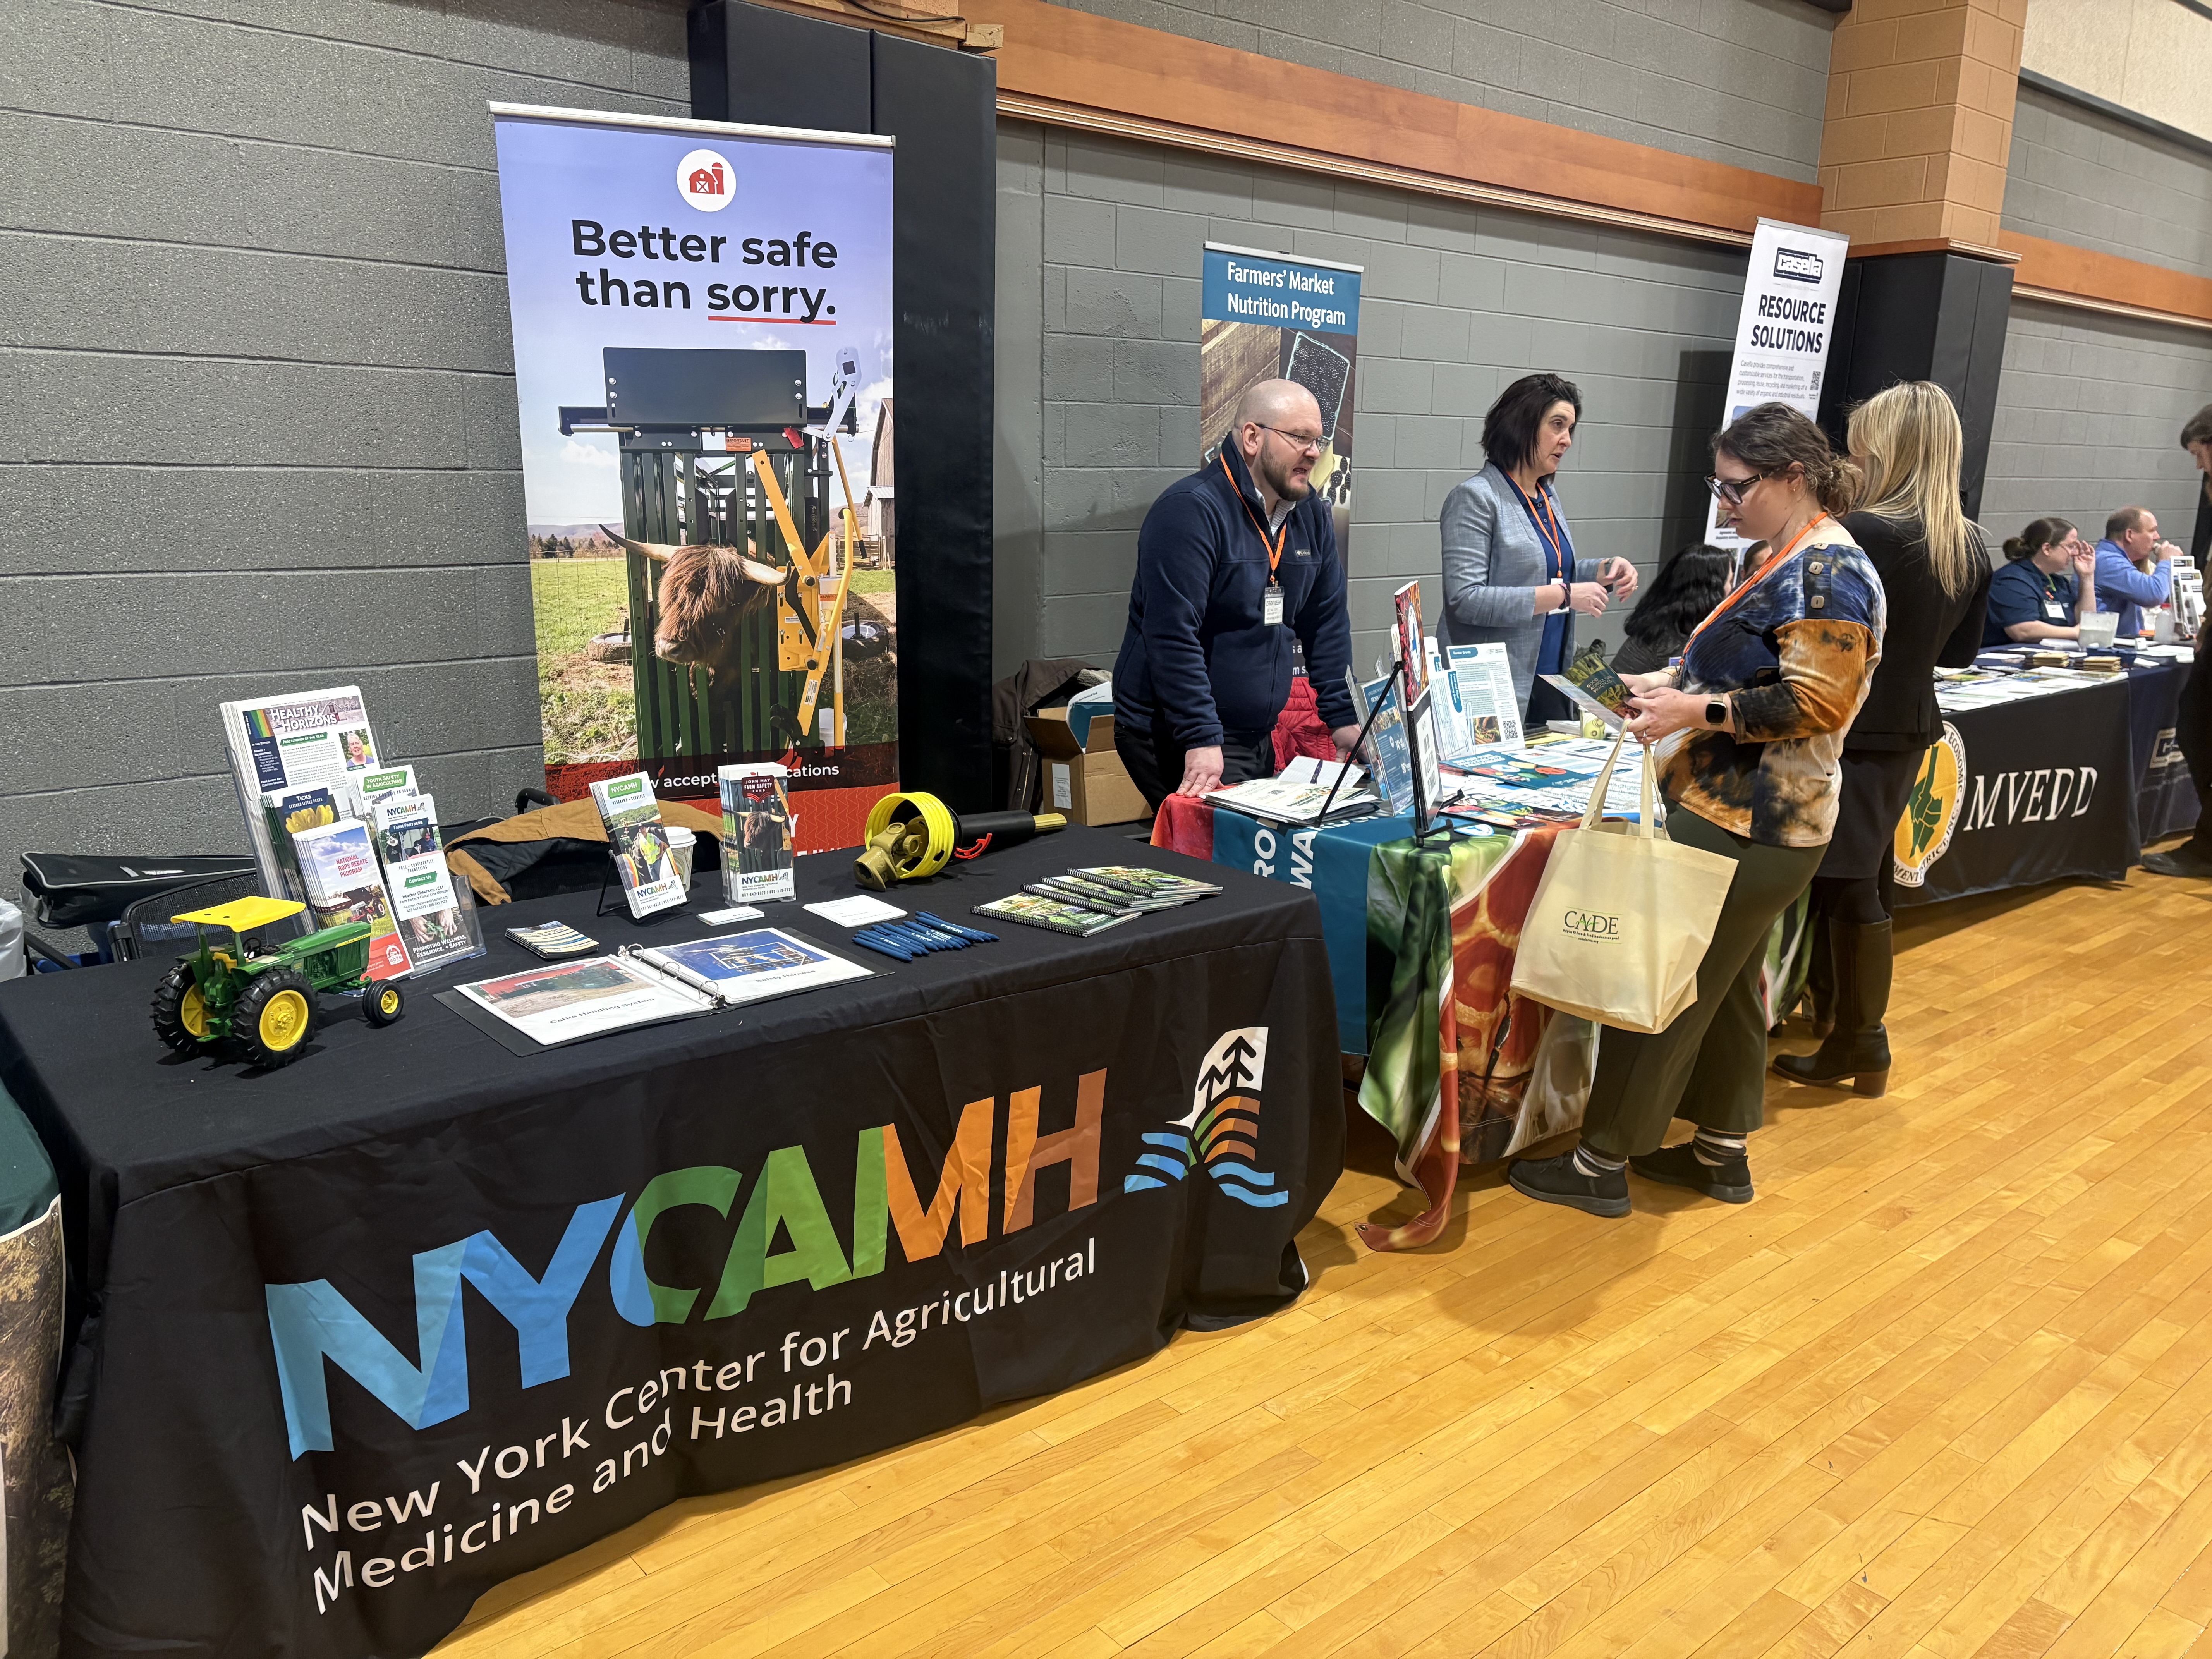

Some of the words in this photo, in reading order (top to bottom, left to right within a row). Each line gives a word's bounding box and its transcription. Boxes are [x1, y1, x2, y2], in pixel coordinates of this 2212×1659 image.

[572, 219, 726, 263] Better
[742, 231, 838, 268] safe
[1289, 271, 1334, 295] Market
[576, 268, 690, 309] than
[708, 284, 836, 323] sorry.
[1228, 293, 1288, 319] Nutrition
[1291, 301, 1345, 328] Program
[1758, 294, 1826, 324] RESOURCE
[1751, 325, 1823, 353] SOLUTIONS
[270, 705, 319, 721] HEALTHY
[281, 714, 338, 732] HORIZONS
[1949, 731, 1963, 793] ECONOMIC
[372, 779, 403, 788] AGRICULTURE
[611, 781, 638, 793] NYCAMH
[664, 774, 718, 790] accept
[787, 764, 839, 778] cations
[386, 804, 417, 816] NYCAMH
[1964, 766, 2098, 831] MVEDD
[336, 854, 359, 865] NATIONAL
[338, 863, 351, 871] ROPS
[351, 858, 368, 868] REBATE
[340, 867, 363, 878] PROGRAM
[742, 873, 778, 885] NYCAMH
[637, 883, 668, 898] NYCAMH
[1564, 911, 1619, 934] CADE
[413, 940, 440, 954] PROMOTING
[449, 940, 467, 949] SAFETY
[550, 1015, 577, 1024] Cattle
[579, 1005, 620, 1017] Handling
[621, 998, 655, 1007] System
[265, 1067, 1108, 1462] NYCAMH
[300, 1479, 442, 1552] New
[457, 1412, 590, 1496] York
[605, 1350, 767, 1436] Center
[780, 1324, 852, 1373] for
[862, 1237, 1096, 1353] Agricultural
[312, 1477, 575, 1616] Medicine
[593, 1408, 672, 1491] and
[689, 1373, 853, 1442] Health
